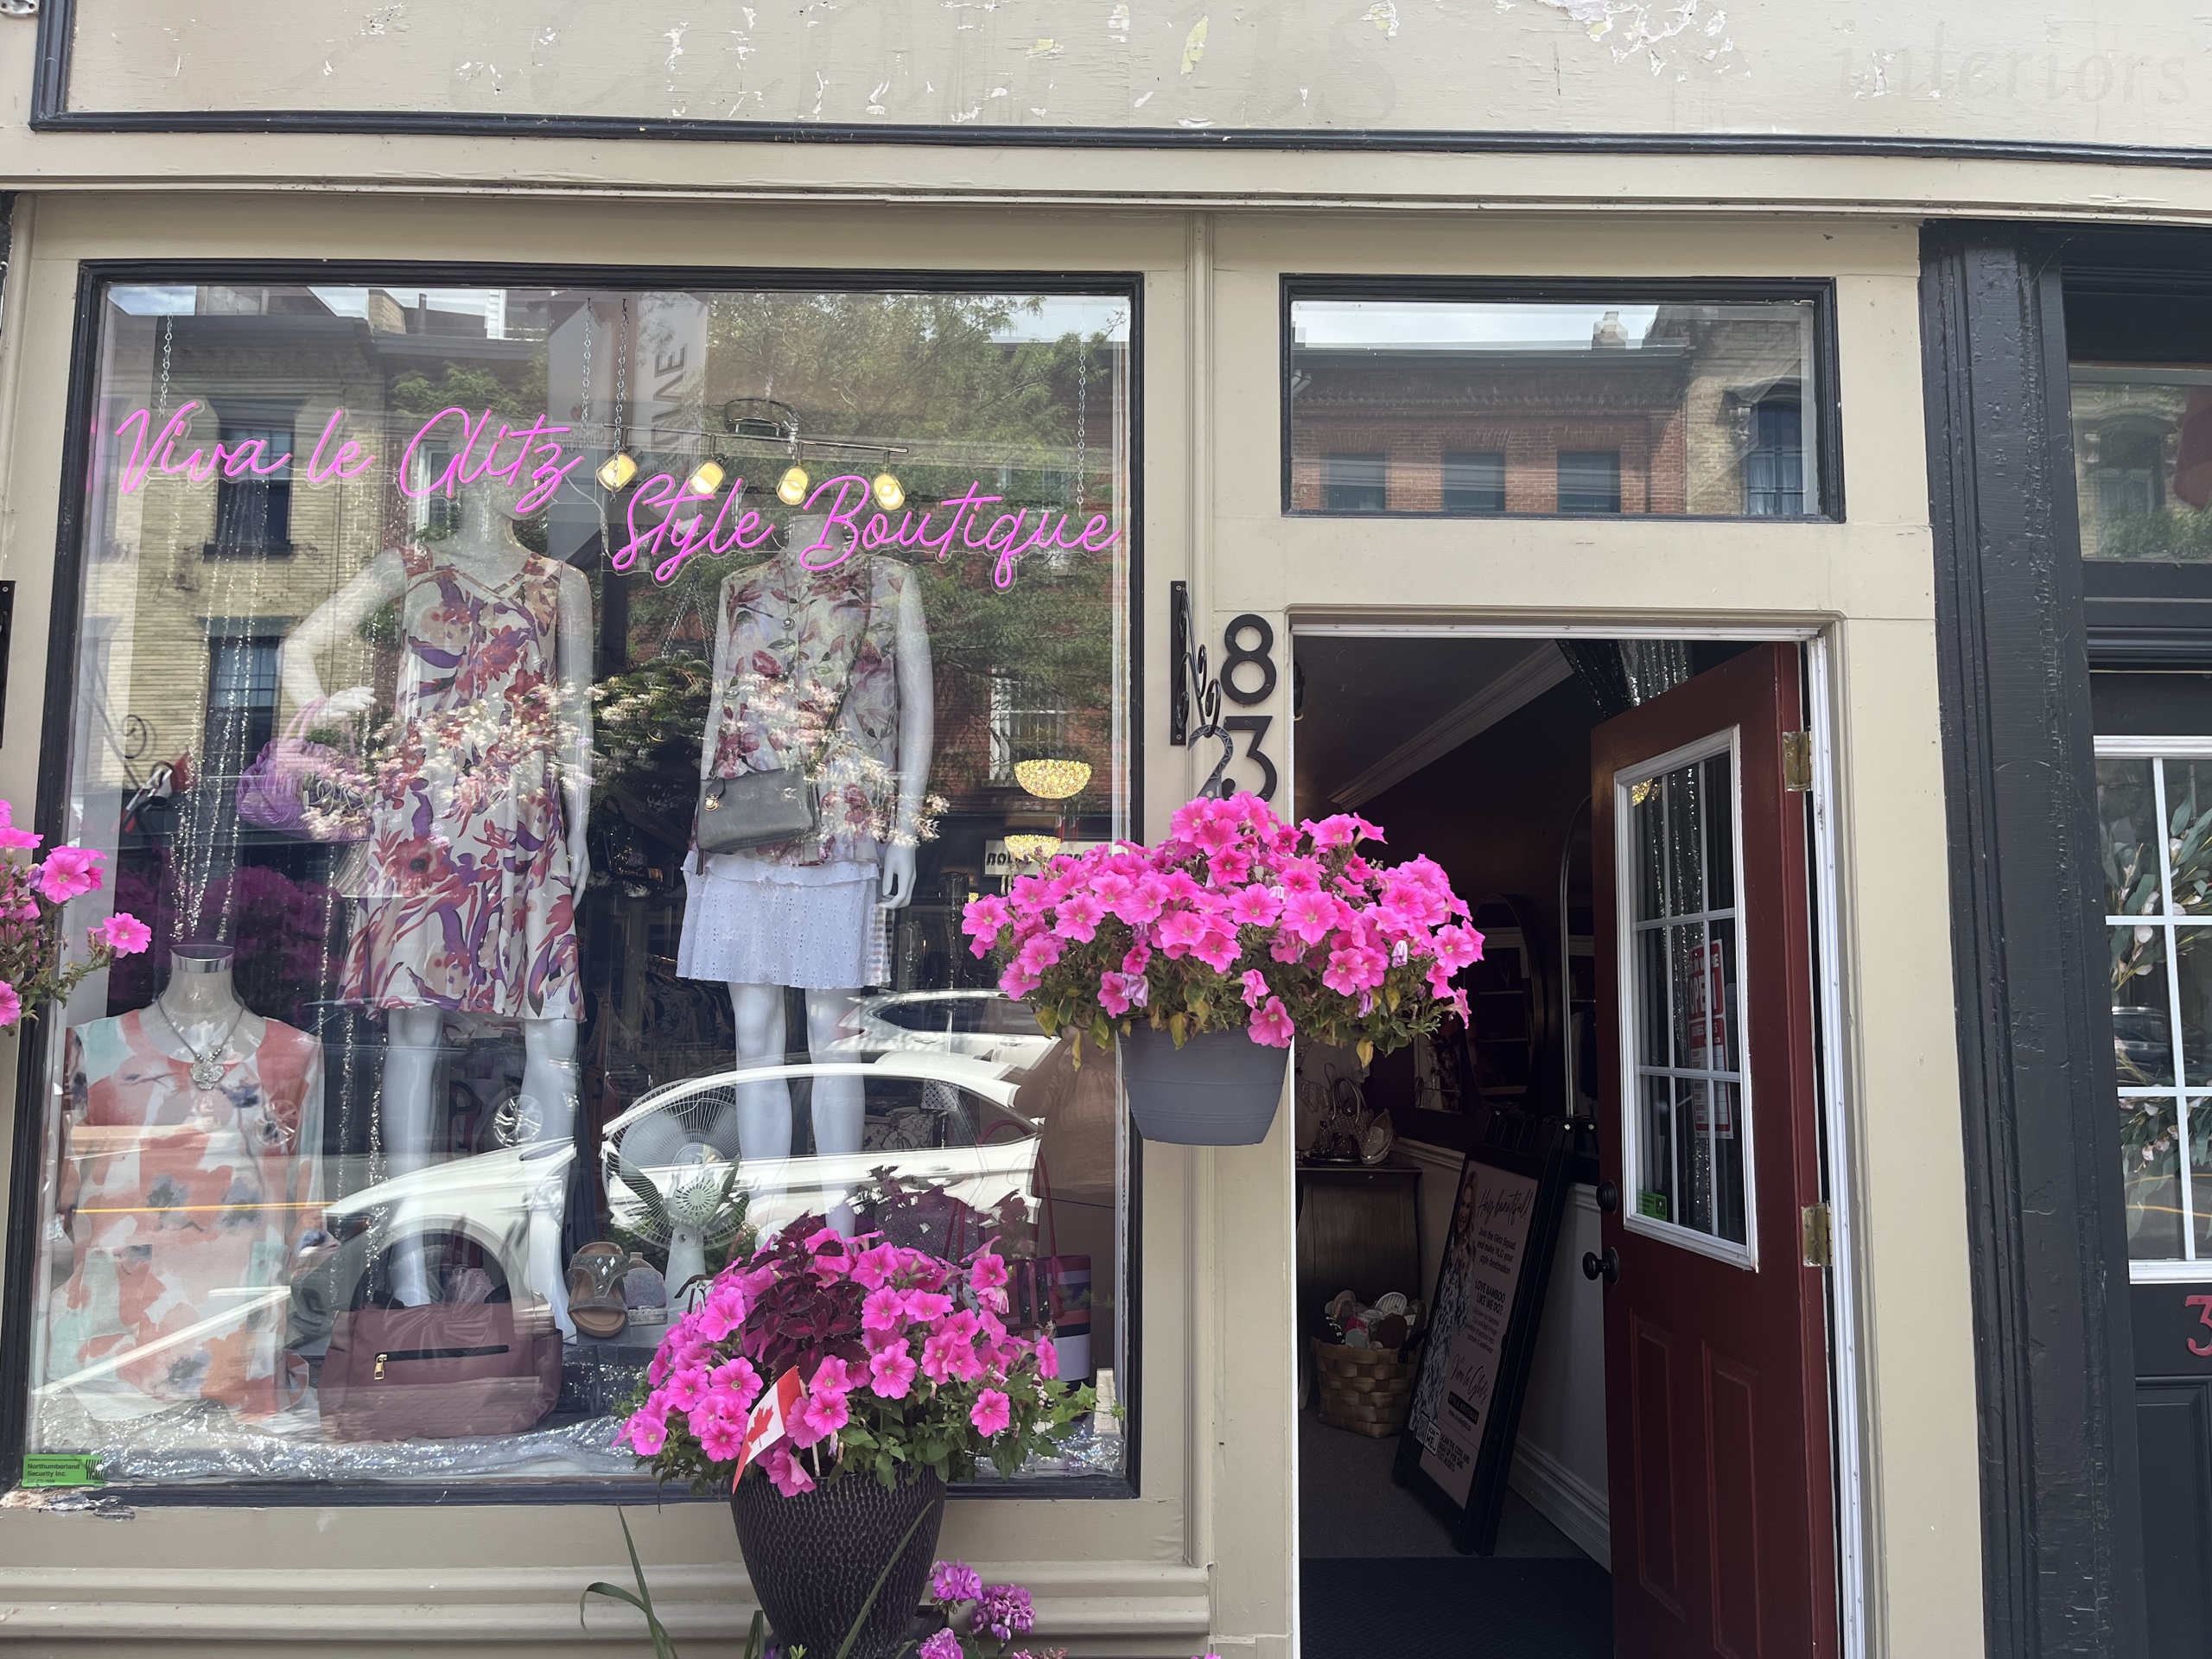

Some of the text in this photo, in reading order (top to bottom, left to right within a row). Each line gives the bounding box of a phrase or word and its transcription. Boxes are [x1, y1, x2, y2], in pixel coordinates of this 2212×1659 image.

[117, 403, 581, 512] Viva le Glitz
[613, 474, 1119, 587] Style Boutique
[1503, 1237, 1516, 1249] Squad
[1474, 1279, 1505, 1303] LOVE BAMBOO
[1476, 1293, 1503, 1315] LIKE WE DO?
[1425, 1433, 1433, 1447] ME
[1454, 1446, 1463, 1459] CODE
